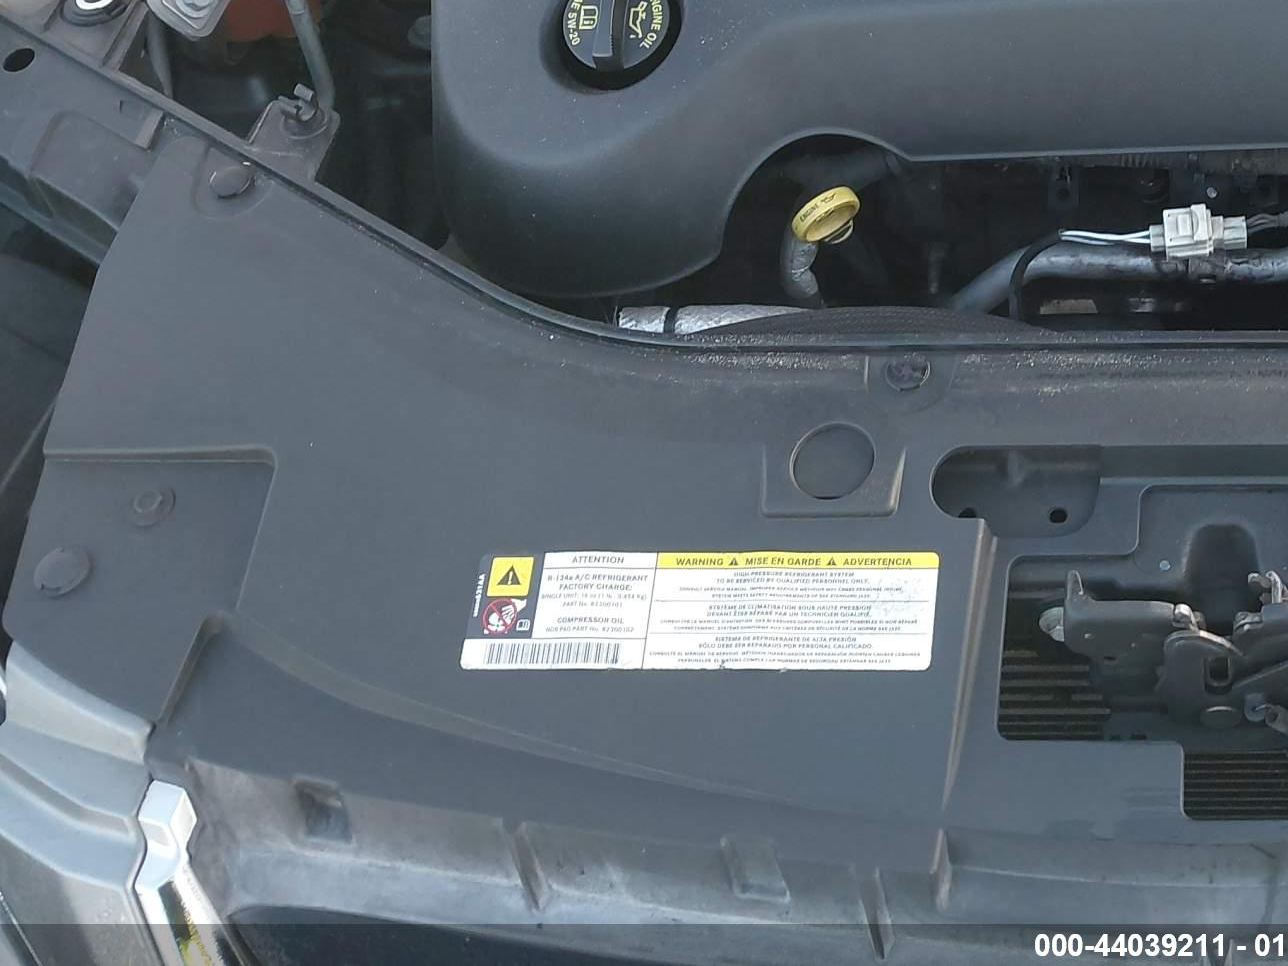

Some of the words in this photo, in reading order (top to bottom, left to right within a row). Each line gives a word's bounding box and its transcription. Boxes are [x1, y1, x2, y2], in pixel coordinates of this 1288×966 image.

[567, 11, 581, 46] 5W-20
[639, 32, 658, 49] OIL
[799, 203, 819, 223] ENGINE
[571, 555, 625, 565] ATTENTION
[675, 557, 724, 566] WARNING
[745, 557, 769, 566] MISE
[770, 557, 785, 565] EN
[787, 557, 821, 566] GARDE
[842, 557, 912, 567] ADVERTENCIA
[547, 573, 573, 582] R-134a
[574, 573, 590, 582] A/C
[591, 573, 649, 583] REFRIGERANT
[735, 577, 765, 585] SERVICED
[776, 577, 811, 585] QUALIFIED
[812, 577, 849, 585] PERSONNEL
[558, 583, 593, 591] FACTORY
[596, 583, 633, 591] CHARGE:
[556, 616, 610, 624] COMPRESSOR
[611, 616, 625, 625] OIL
